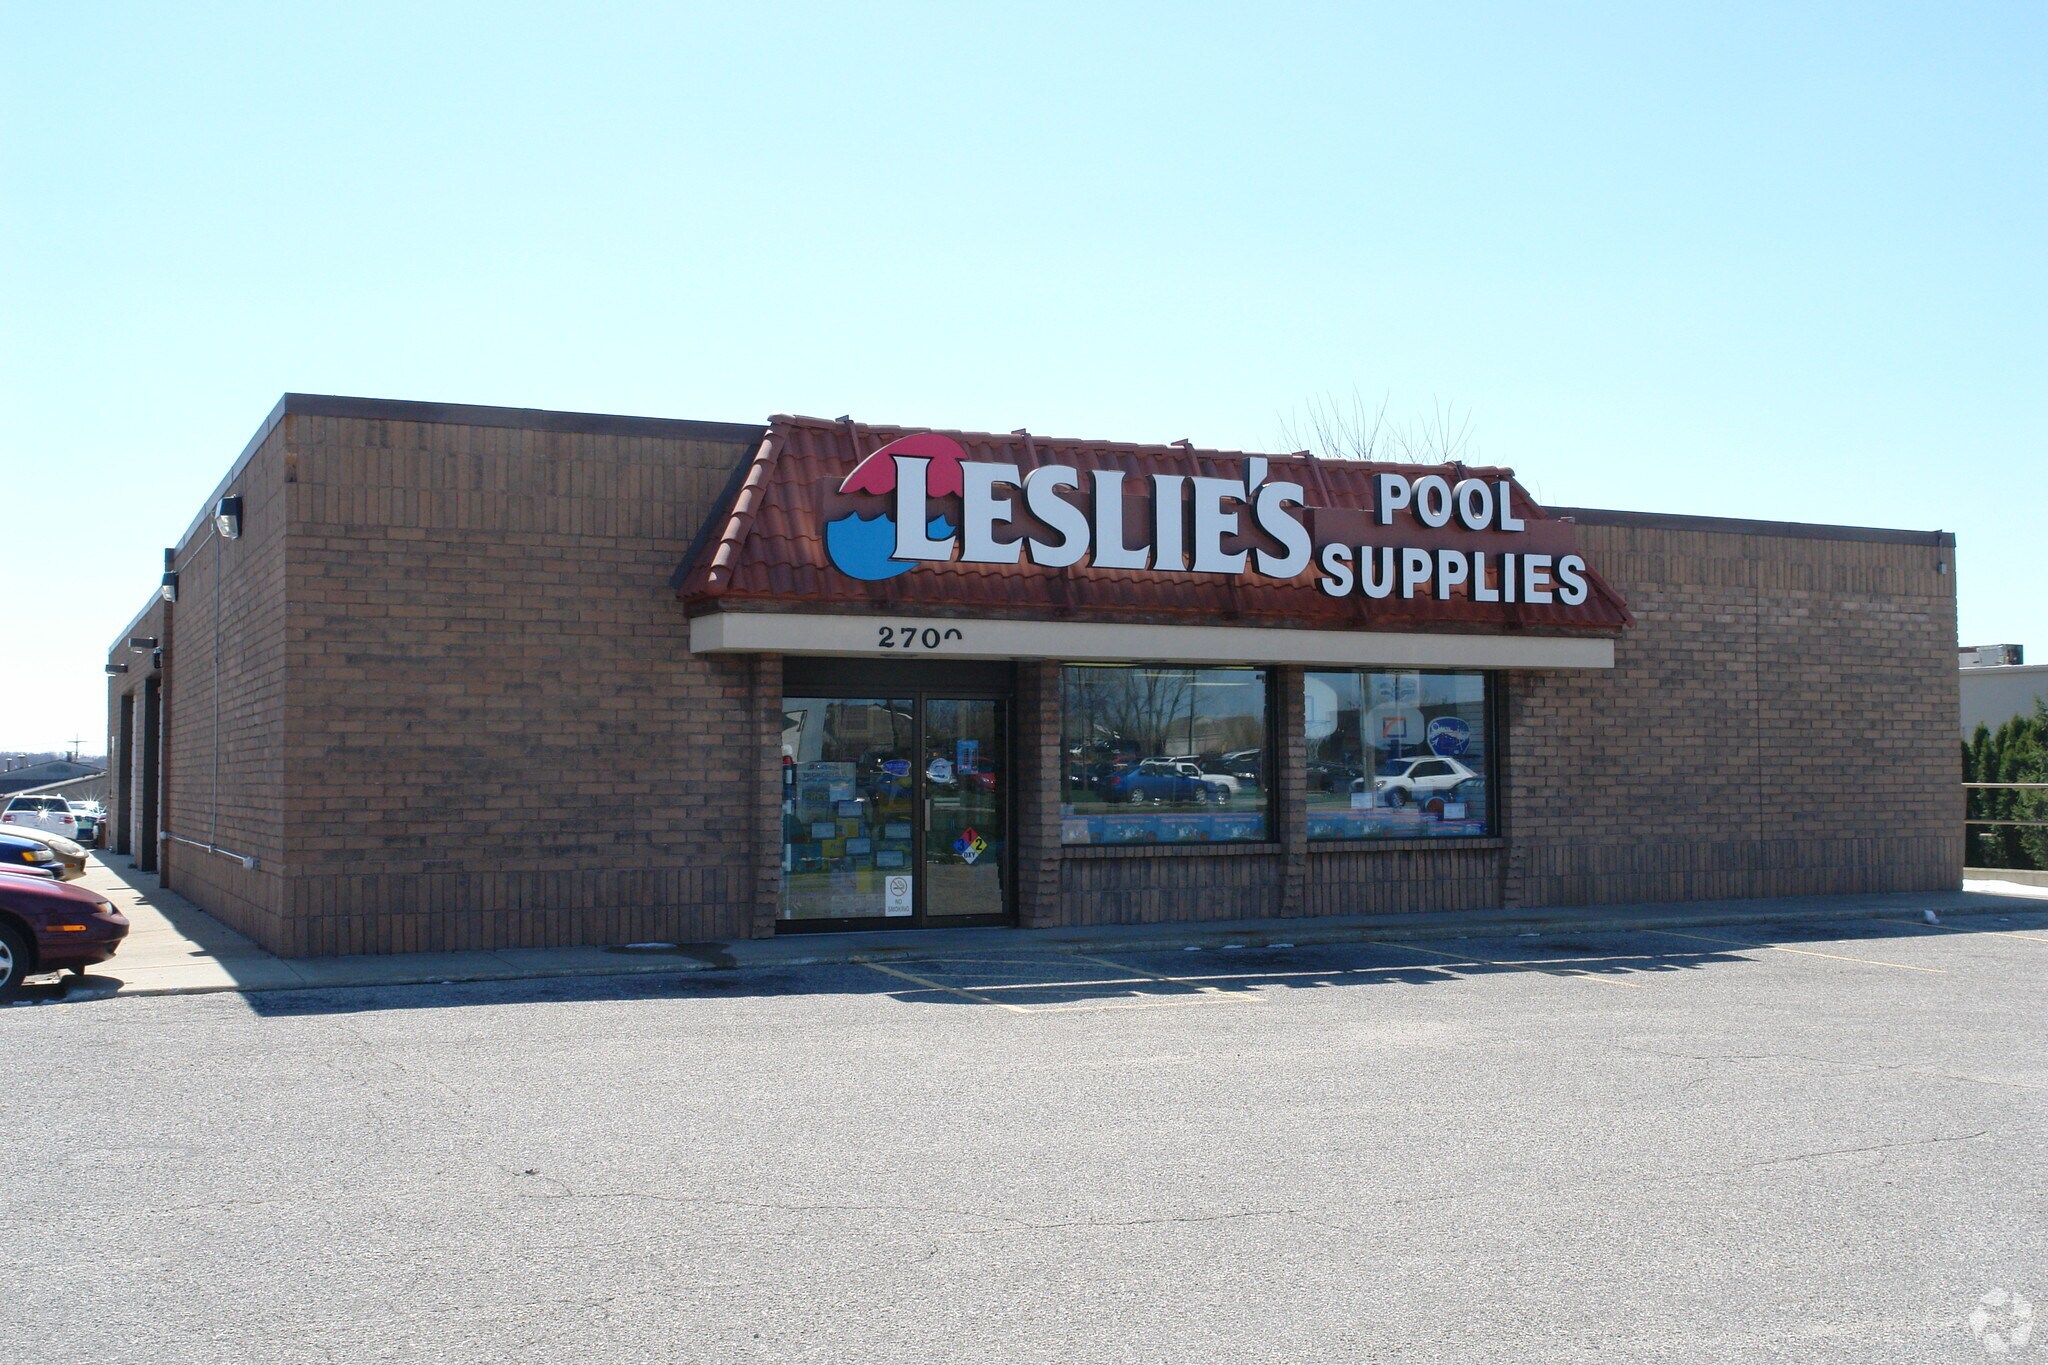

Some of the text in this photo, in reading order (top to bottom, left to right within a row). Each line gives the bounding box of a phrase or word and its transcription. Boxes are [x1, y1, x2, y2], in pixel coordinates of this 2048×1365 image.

[890, 455, 1312, 579] LESLIE'S
[1375, 473, 1525, 532] POOL
[1317, 542, 1588, 606] SUPPLIES
[957, 839, 965, 851] 3
[966, 830, 972, 842] 1
[975, 838, 983, 851] 2
